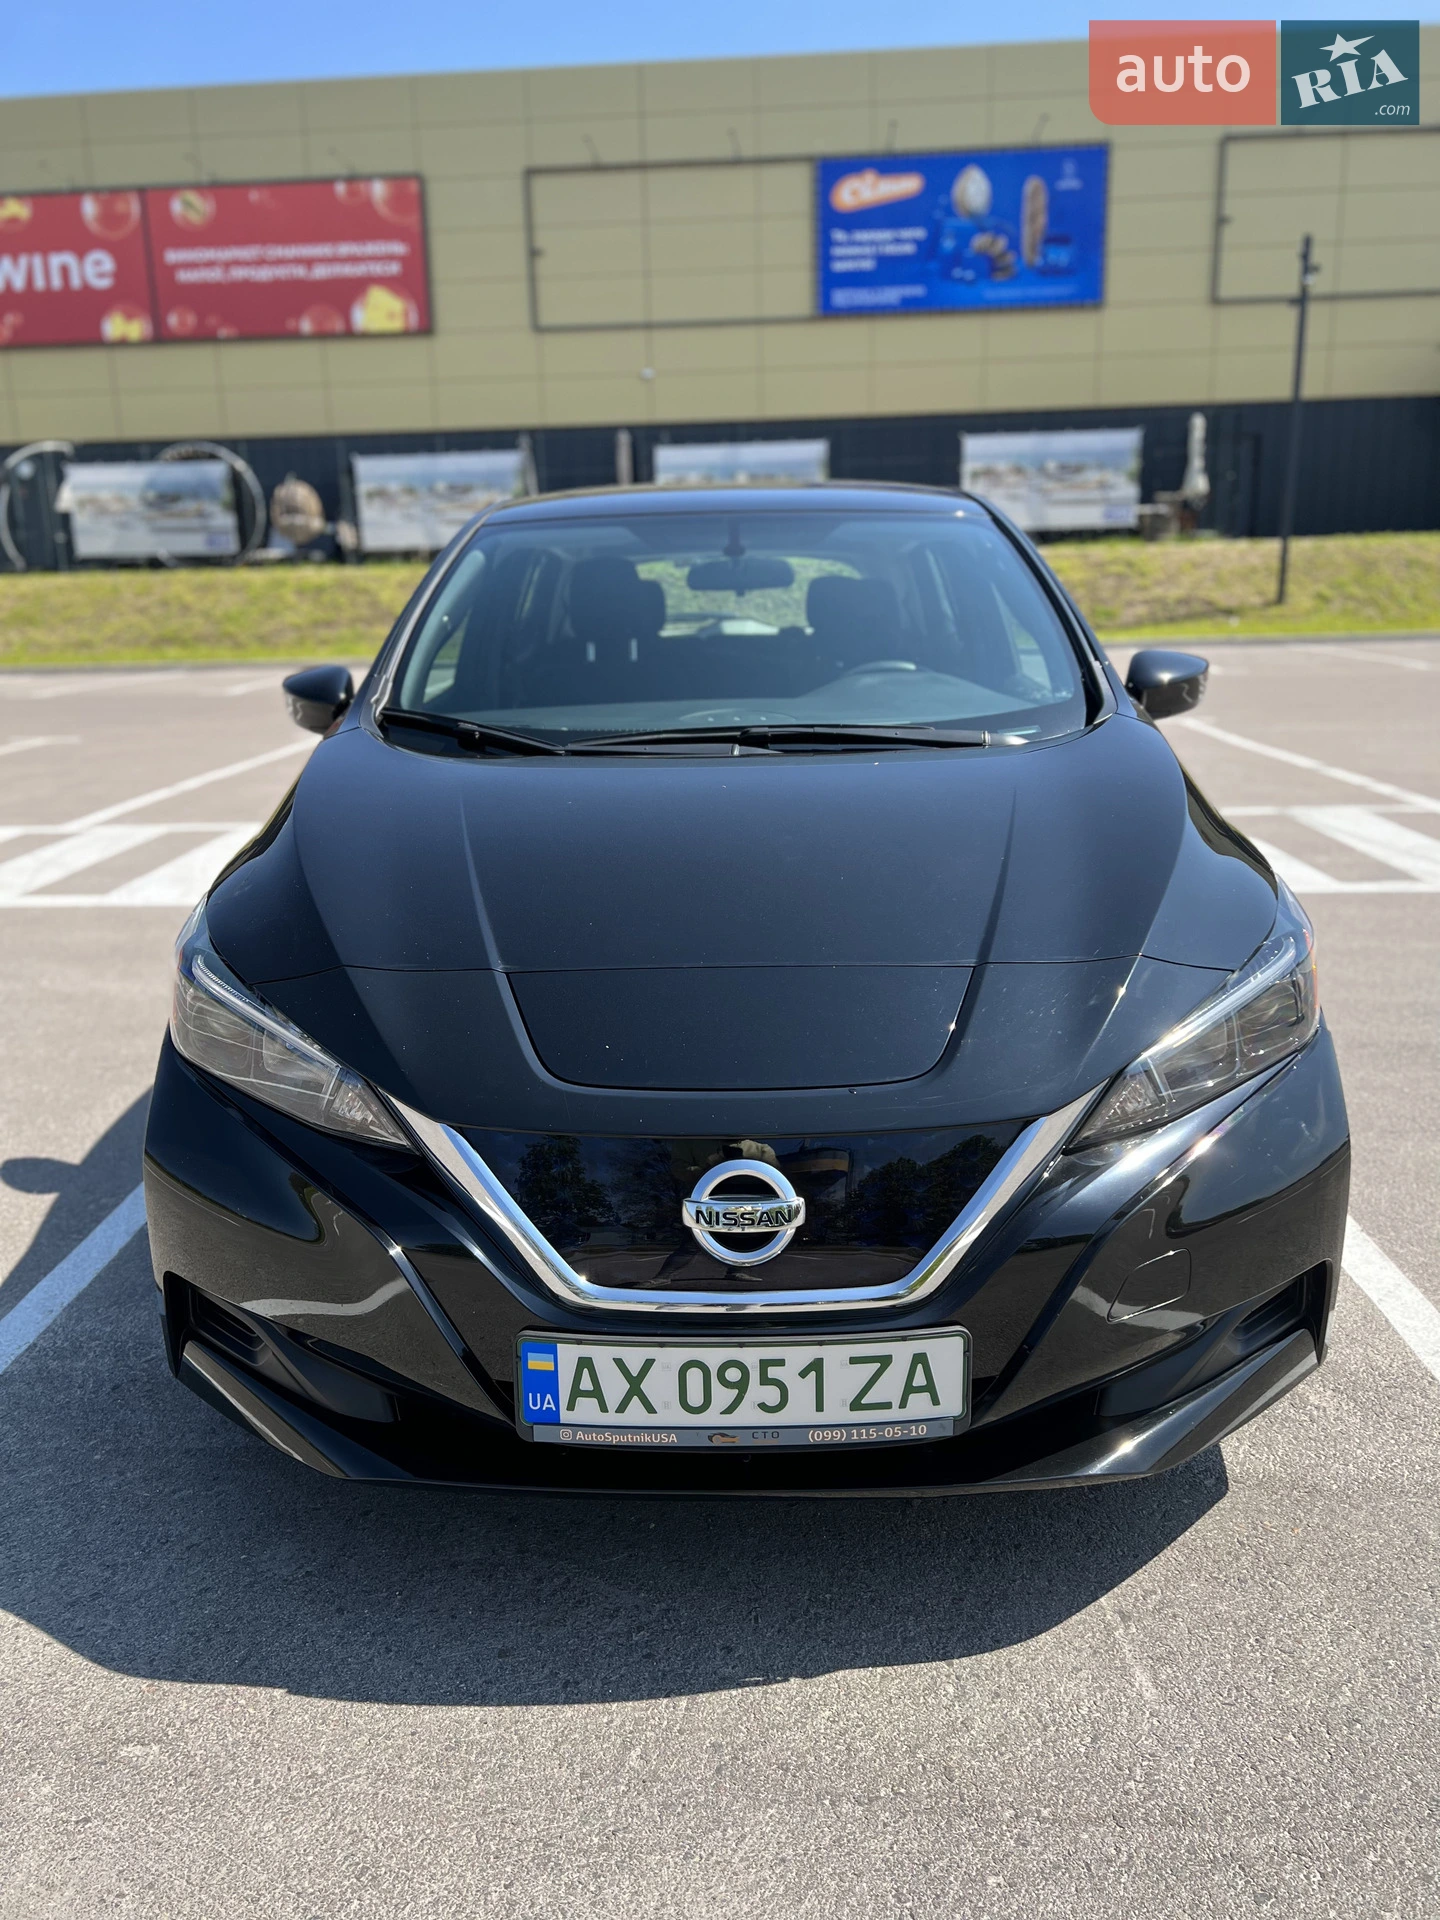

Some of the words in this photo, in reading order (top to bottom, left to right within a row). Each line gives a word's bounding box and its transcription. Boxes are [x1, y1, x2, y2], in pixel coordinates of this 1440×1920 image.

[695, 1208, 792, 1227] NISSAN
[566, 1356, 658, 1415] AX
[678, 1357, 825, 1415] 0951
[849, 1352, 941, 1412] ZA
[528, 1392, 556, 1411] UA
[575, 1430, 678, 1444] AutoSputnikUSA
[808, 1428, 847, 1443] (099)
[851, 1424, 927, 1440] 115-05-10
